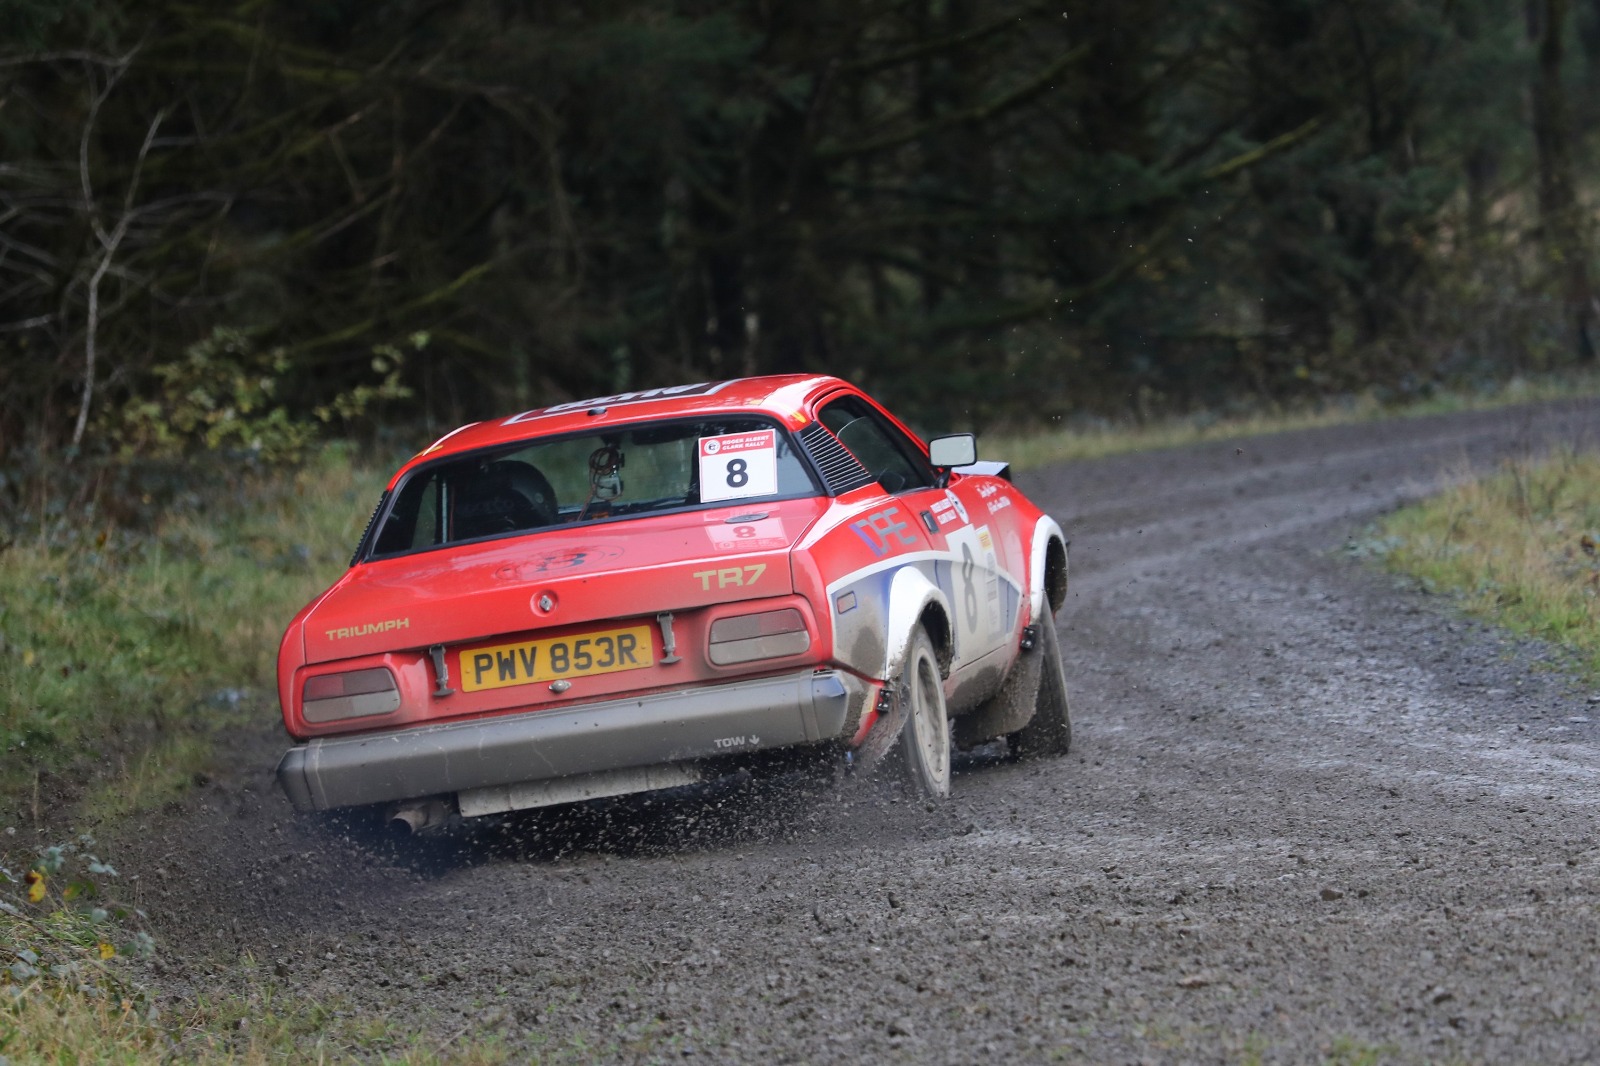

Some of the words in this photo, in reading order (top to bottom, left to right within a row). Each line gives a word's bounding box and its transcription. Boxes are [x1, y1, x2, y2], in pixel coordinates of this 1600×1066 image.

[726, 458, 749, 488] 8
[693, 563, 767, 591] TR7
[962, 541, 978, 634] 8
[325, 617, 410, 641] TRIUMPH
[473, 646, 538, 685] PWV
[551, 633, 638, 674] 853R
[714, 736, 745, 749] TOW
